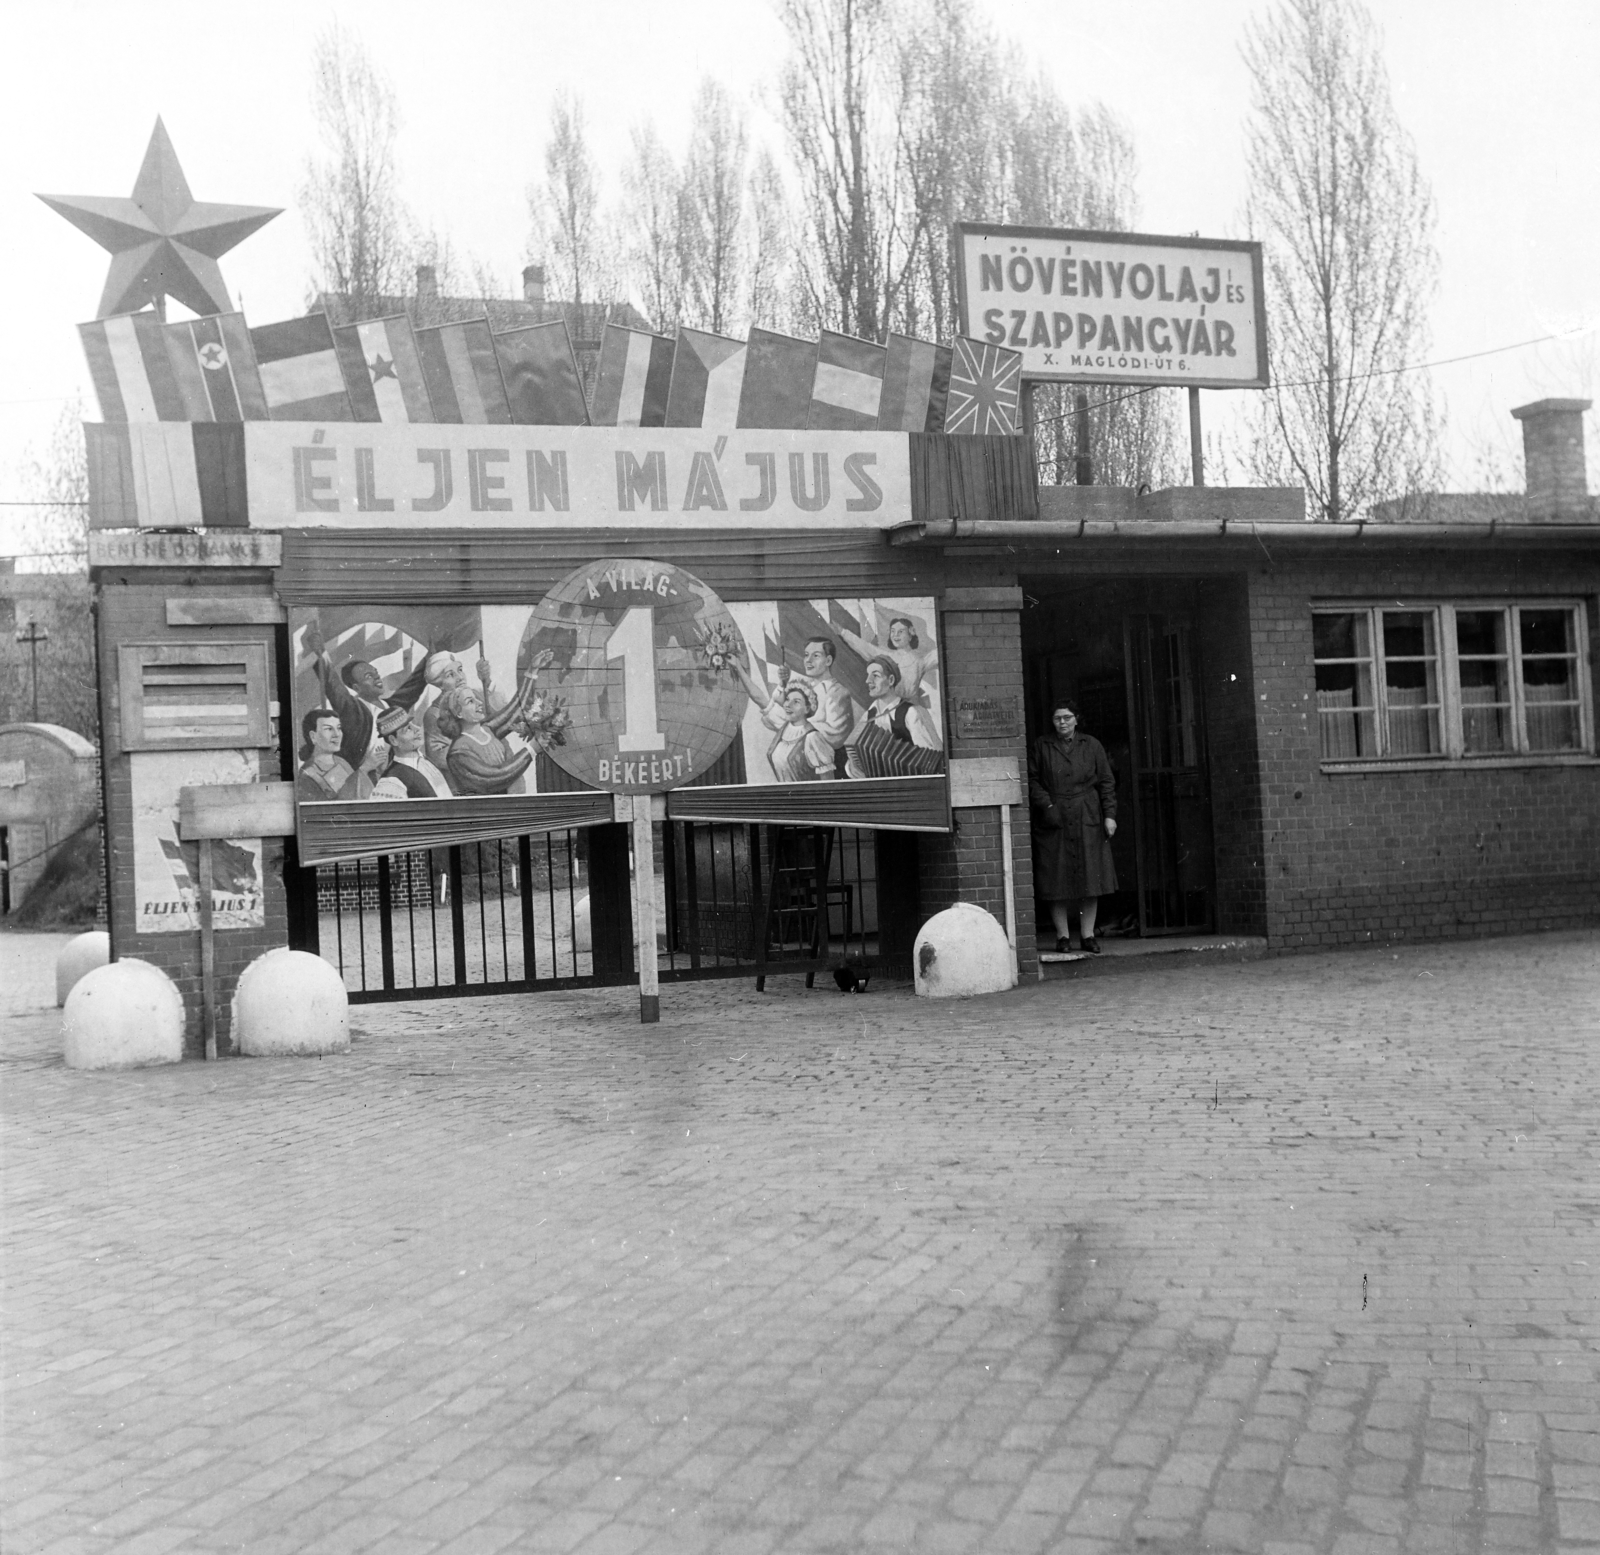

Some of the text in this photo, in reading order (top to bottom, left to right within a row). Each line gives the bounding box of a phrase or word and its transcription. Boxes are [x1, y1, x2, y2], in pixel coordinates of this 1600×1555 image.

[980, 246, 1220, 304] NÖVÉNYOLAJ
[983, 305, 1237, 357] SZAPPANGYÁR
[1043, 353, 1059, 365] X.
[1178, 359, 1191, 371] 6.
[292, 429, 884, 512] ÉLJEN MÁJUS
[586, 578, 601, 601] A
[606, 605, 666, 751] 1
[599, 748, 693, 785] BÉKÉÉRT!
